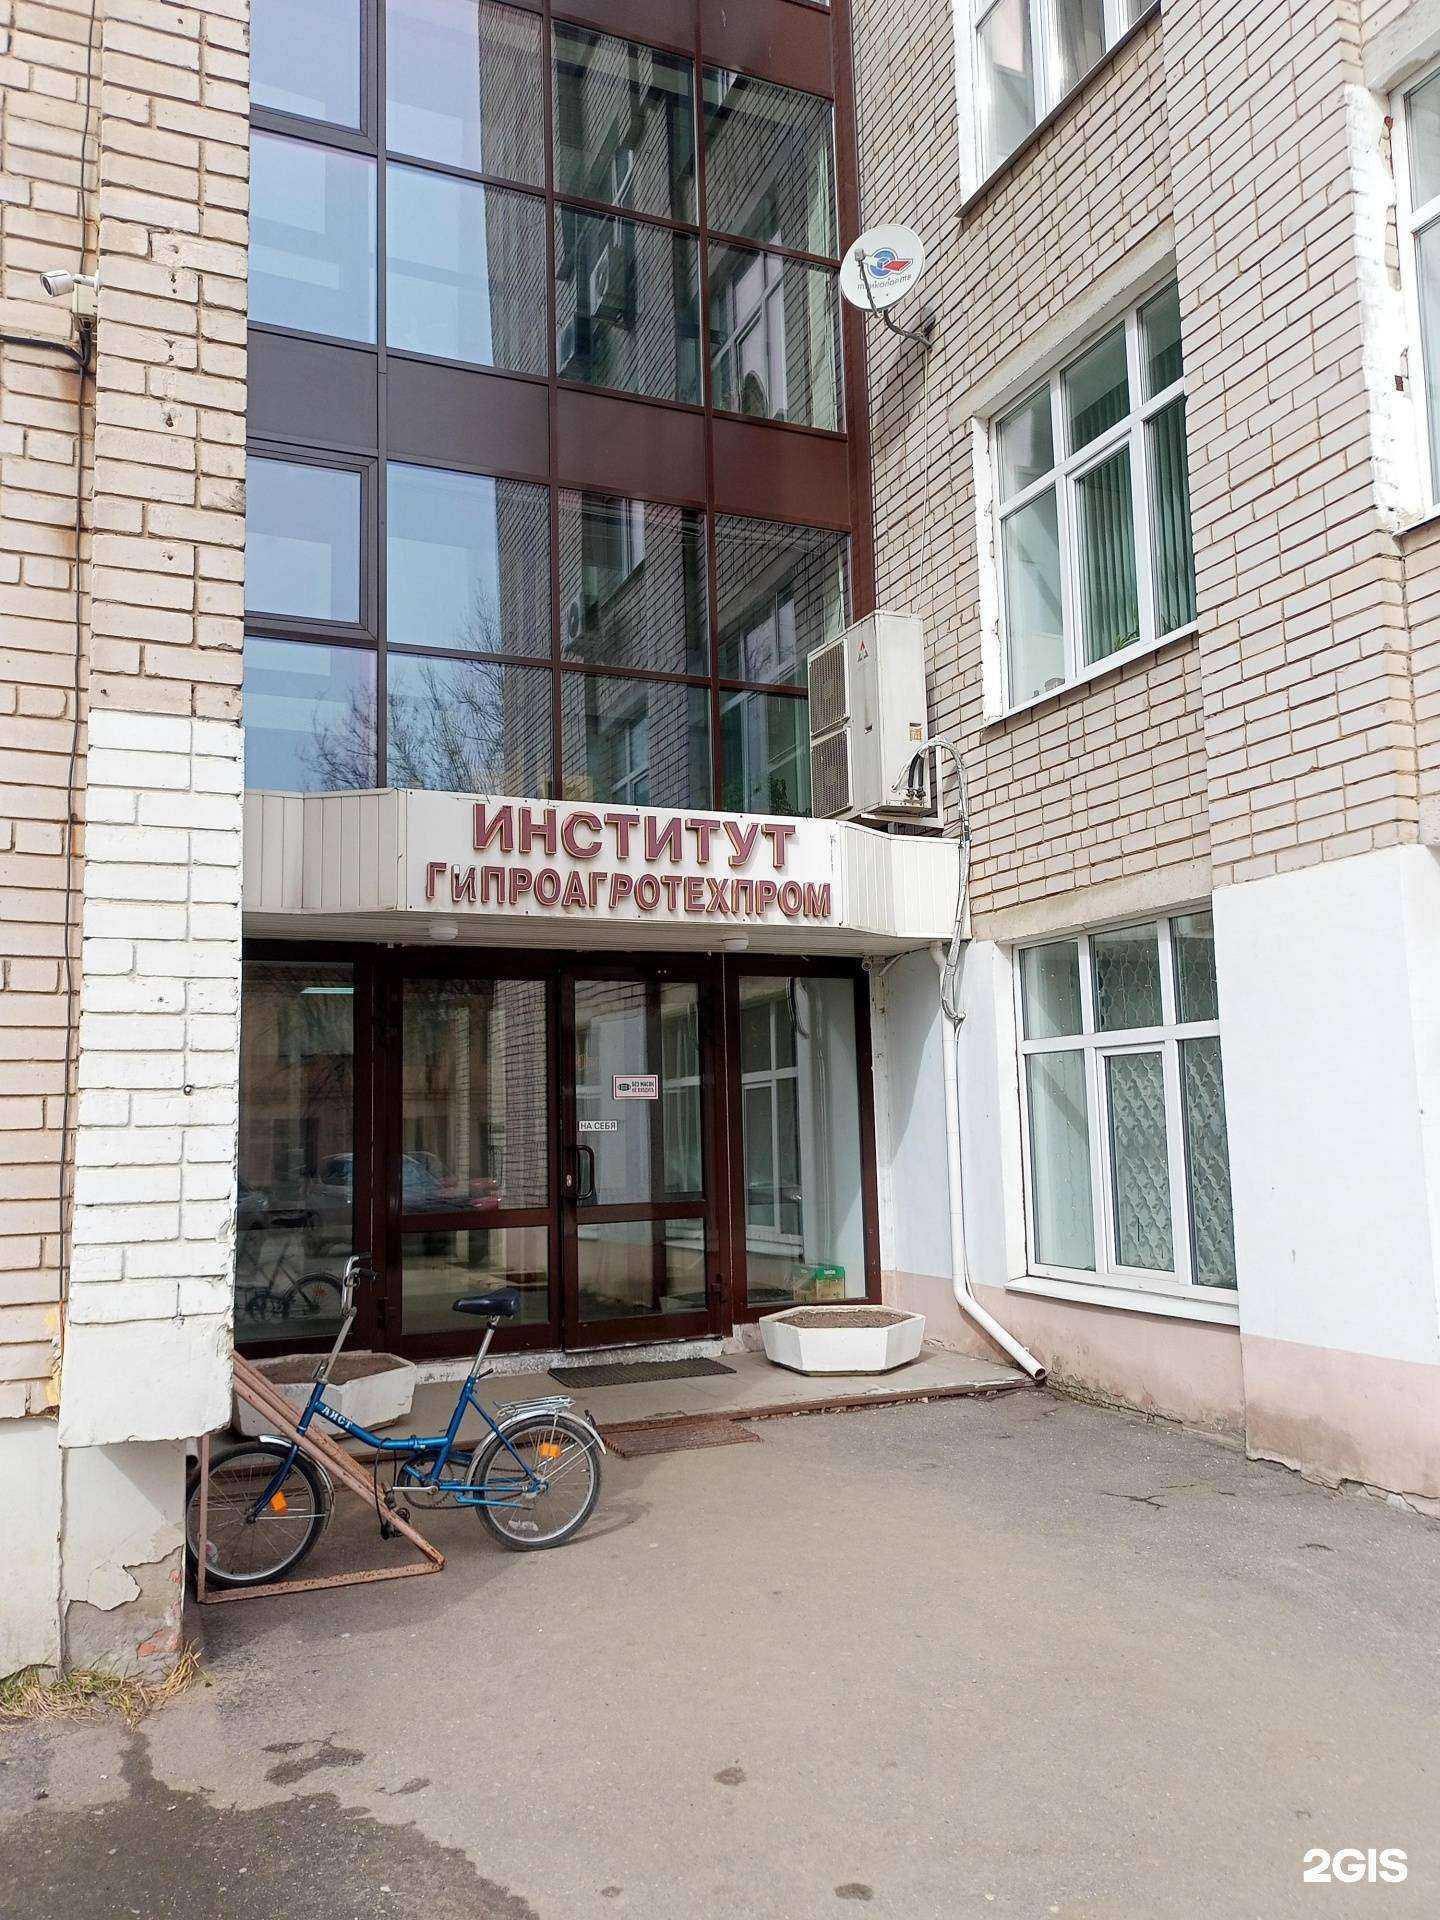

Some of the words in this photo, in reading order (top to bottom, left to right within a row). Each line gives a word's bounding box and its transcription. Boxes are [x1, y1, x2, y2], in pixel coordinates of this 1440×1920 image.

[472, 803, 797, 868] ИНСТИТУТ
[425, 861, 832, 917] ГИПРОАГРОТЕХПРОМ
[580, 1122, 593, 1130] НА
[594, 1121, 616, 1130] СЕБЯ
[321, 1406, 353, 1430] АИСТ
